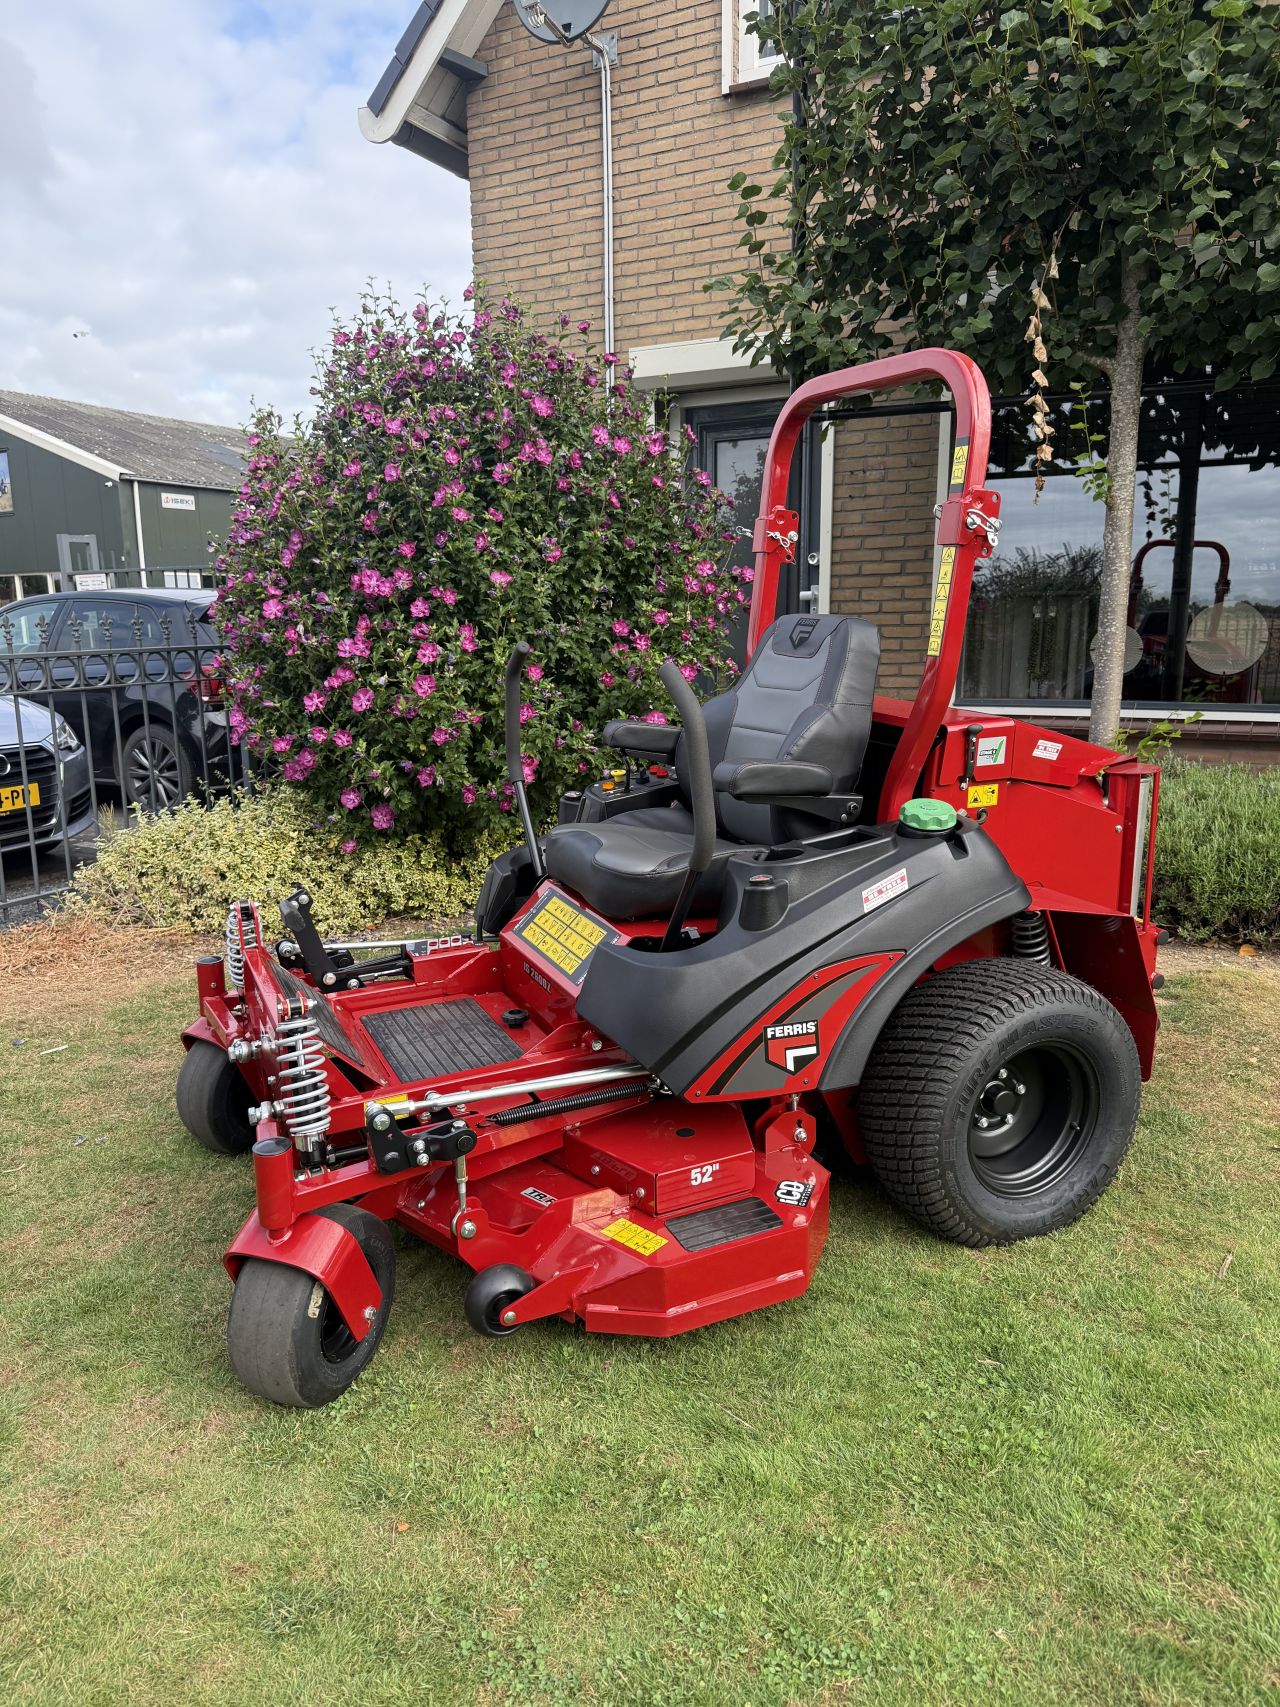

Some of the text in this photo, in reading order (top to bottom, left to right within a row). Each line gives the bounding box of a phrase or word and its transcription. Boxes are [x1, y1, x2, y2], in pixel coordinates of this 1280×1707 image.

[767, 1022, 816, 1039] FERRIS
[952, 1049, 992, 1122] TURF
[690, 1163, 720, 1186] 52"
